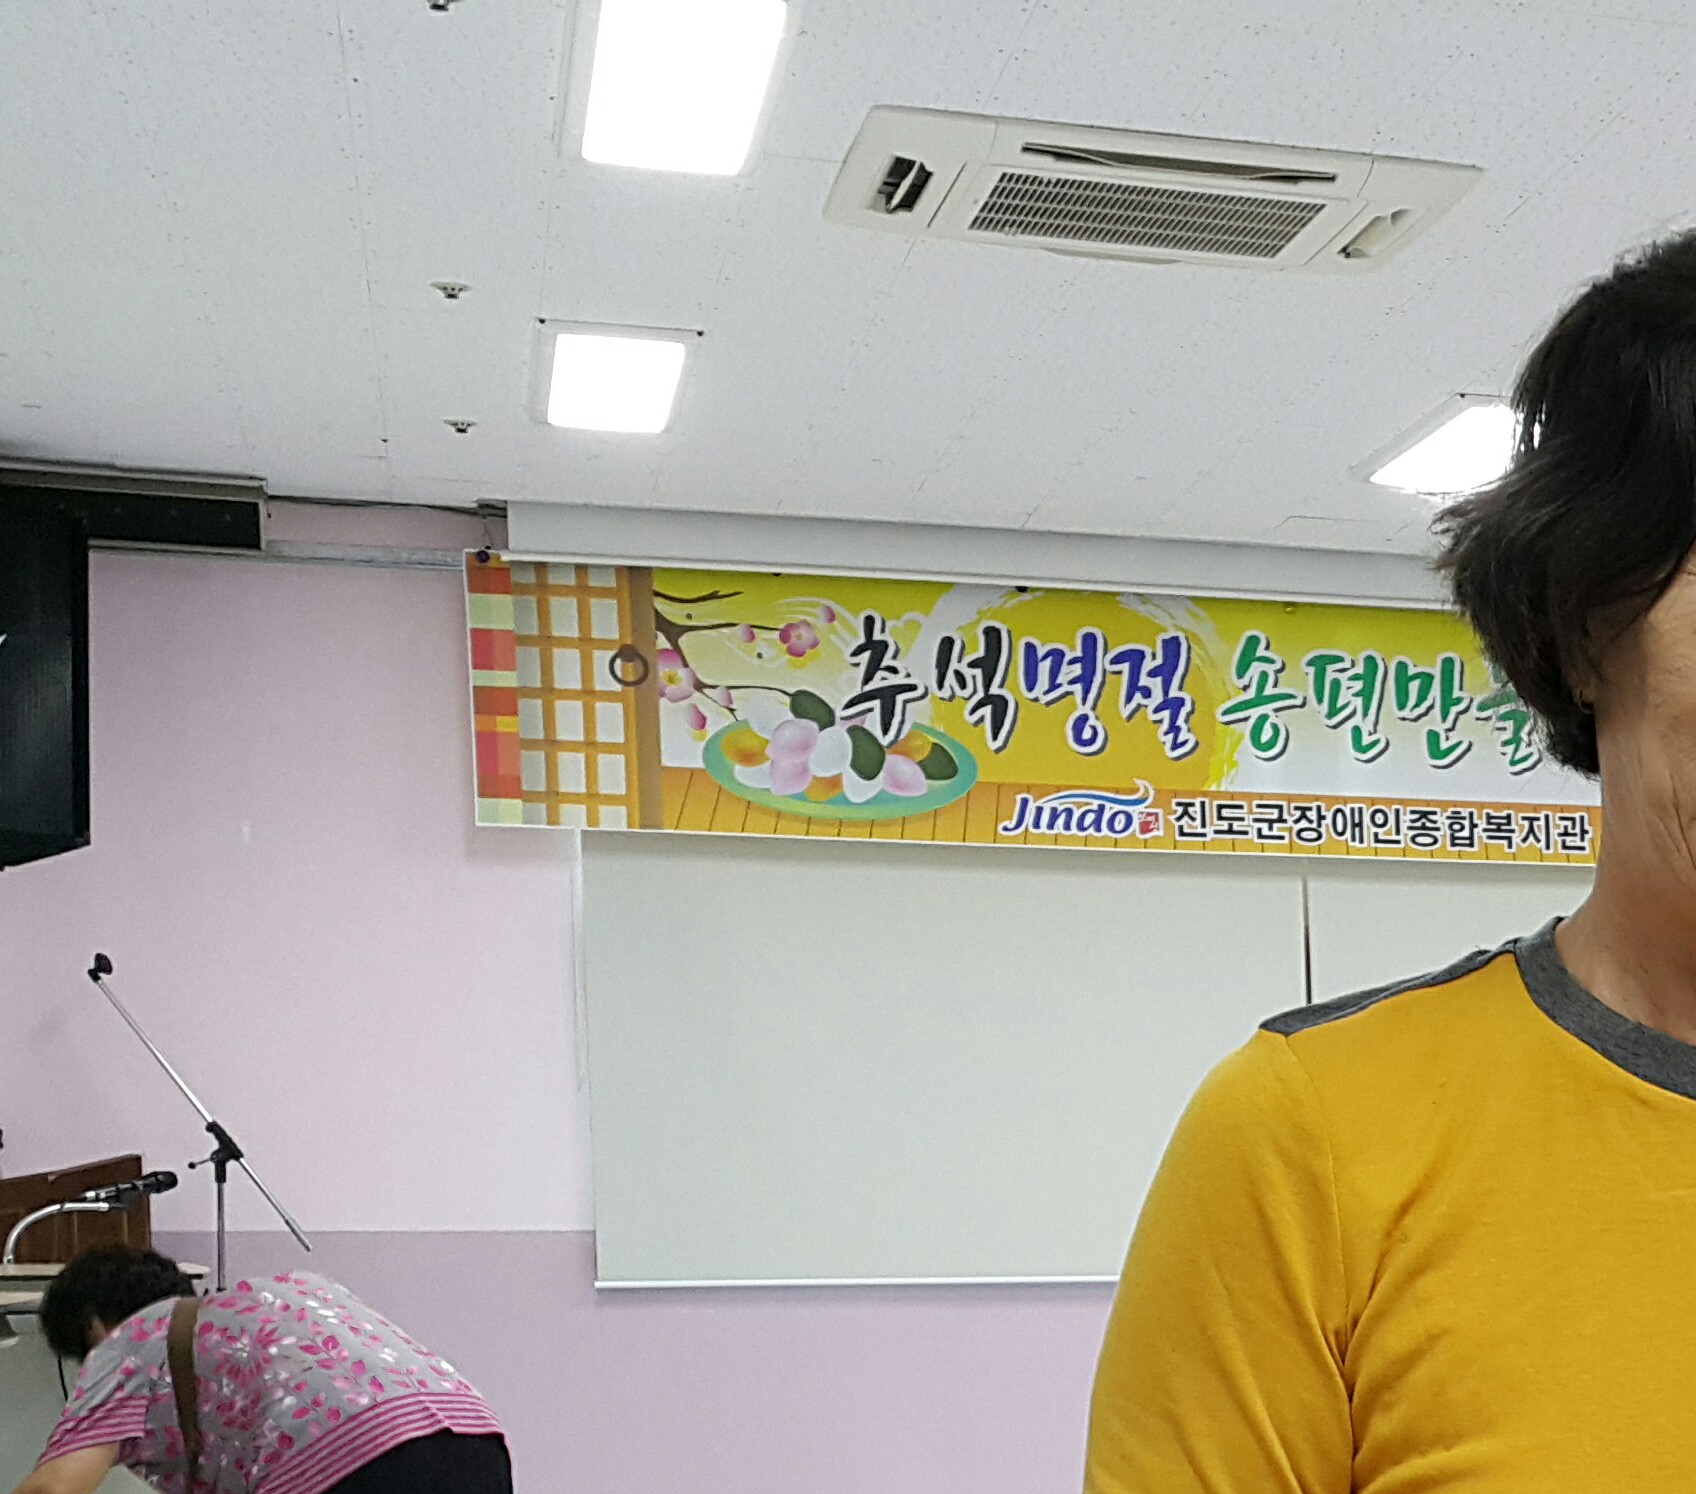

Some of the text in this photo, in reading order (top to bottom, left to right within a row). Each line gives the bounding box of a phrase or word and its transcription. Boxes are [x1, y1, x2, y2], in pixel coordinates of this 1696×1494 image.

[842, 614, 1198, 760] 추석명절
[1001, 796, 1135, 837] Jindo
[1173, 800, 1589, 851] 진도군장애인종합복지관
